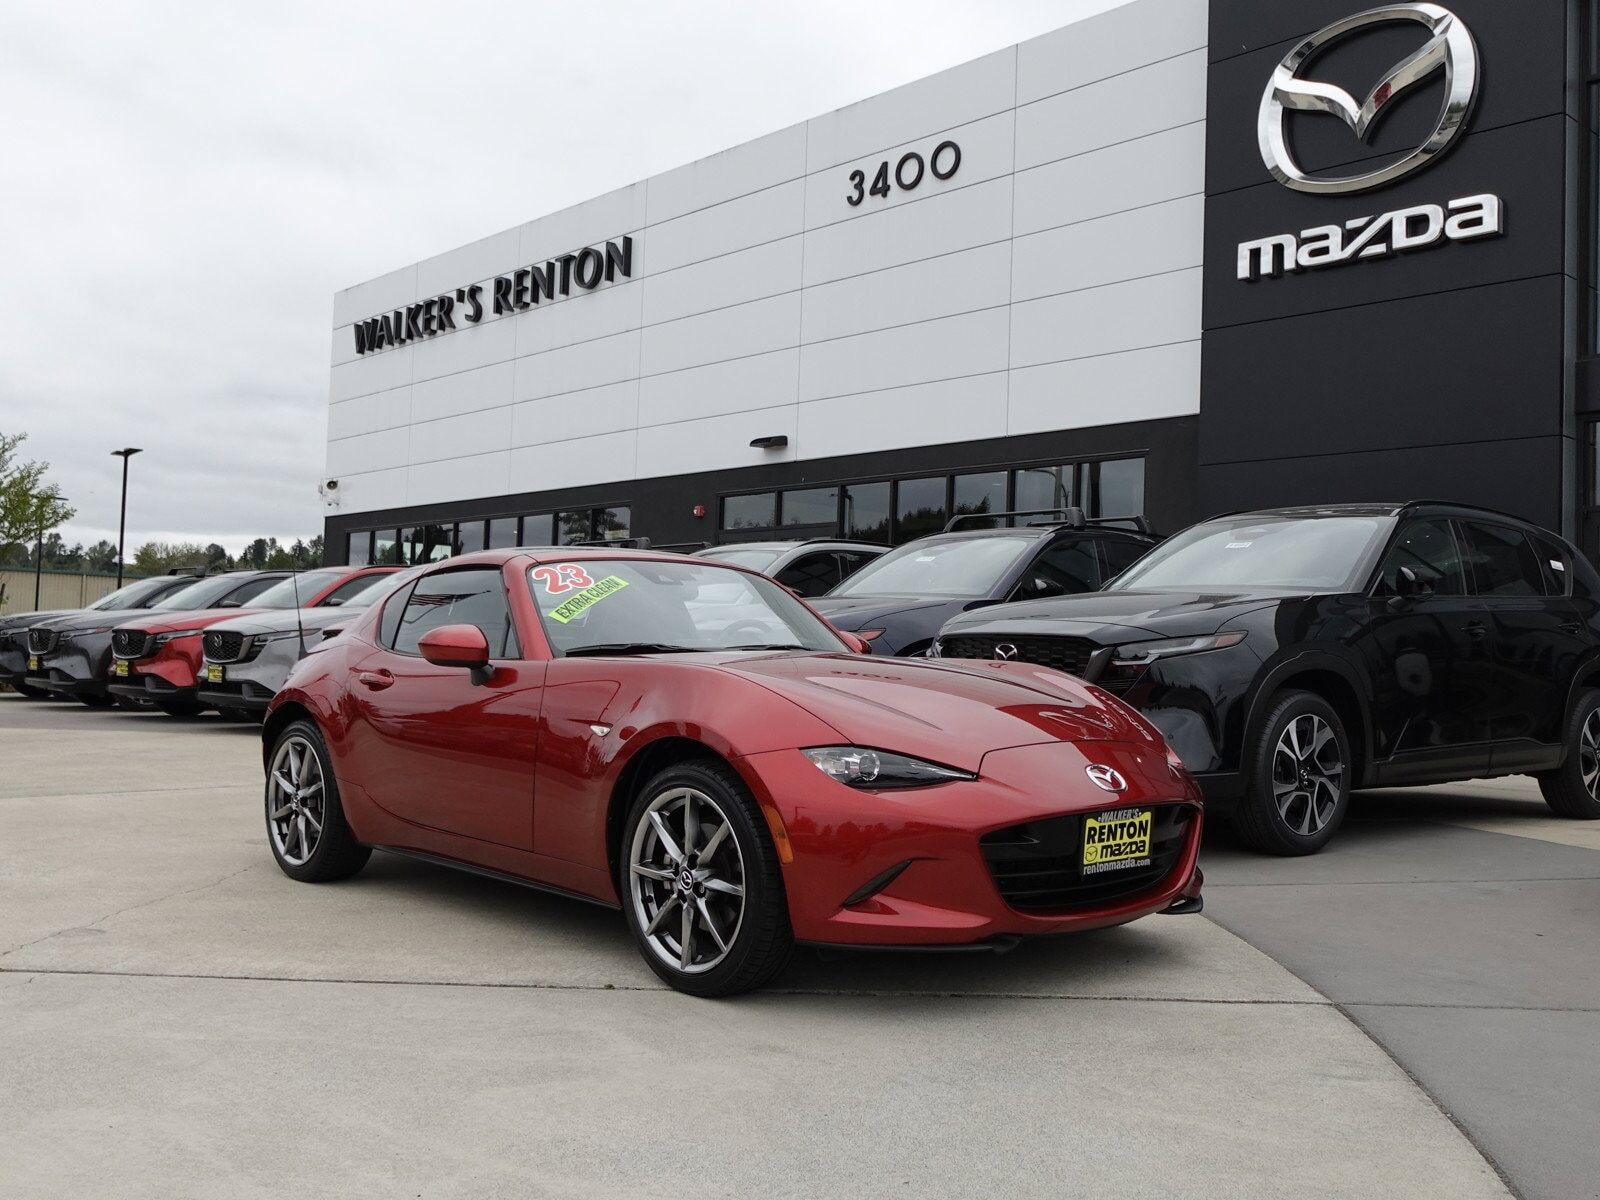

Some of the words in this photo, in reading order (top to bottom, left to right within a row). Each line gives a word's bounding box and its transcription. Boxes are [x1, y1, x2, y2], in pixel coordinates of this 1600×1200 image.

[847, 140, 961, 207] 3400
[354, 285, 483, 355] WALKER'S
[493, 236, 633, 315] RENTON
[532, 563, 594, 595] 23
[555, 593, 593, 619] EXTRA
[586, 578, 624, 598] CLEAN
[1101, 808, 1140, 823] WALKER'S
[1086, 820, 1149, 845] RENTON
[1083, 858, 1151, 875] rentonmazda.com
